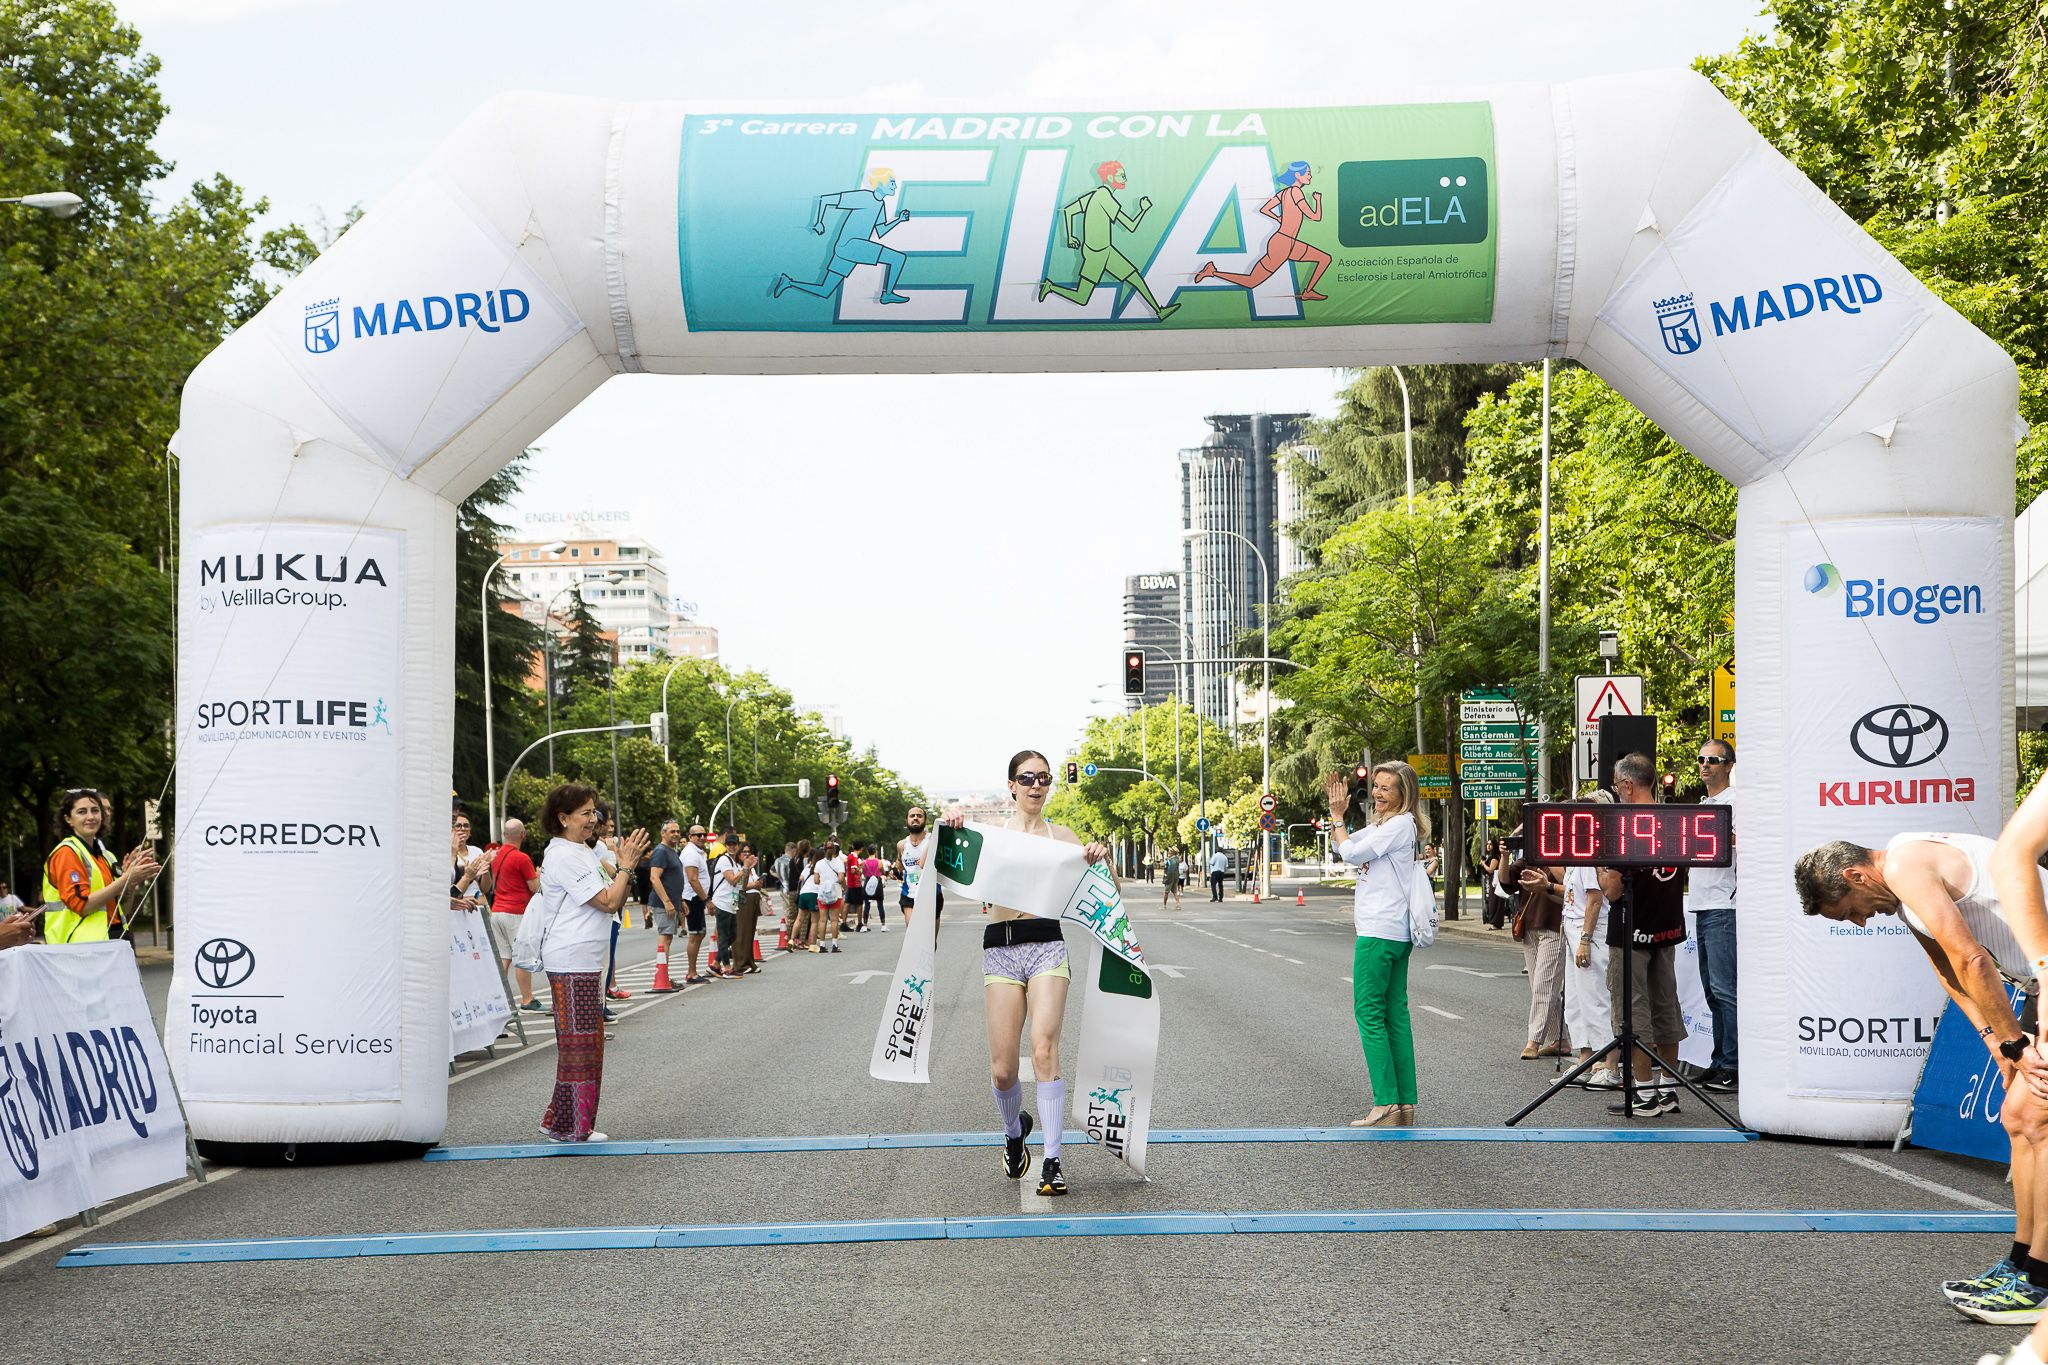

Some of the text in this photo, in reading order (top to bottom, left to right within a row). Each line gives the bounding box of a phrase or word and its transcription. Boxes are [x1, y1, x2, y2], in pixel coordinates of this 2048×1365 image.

[740, 119, 858, 135] Carrera
[871, 116, 1072, 140] MADRID
[1087, 115, 1191, 138] CON
[1205, 113, 1267, 136] LA
[1359, 195, 1468, 228] adELA
[832, 141, 1305, 325] ELA
[1338, 254, 1459, 268] Asociación Española de
[1337, 268, 1488, 283] Esclerosis Lateral Amiotrófica
[353, 288, 530, 339] MADRID
[1709, 273, 1883, 337] MADRID
[201, 553, 387, 588] MUKUA
[1140, 576, 1177, 589] BBVA
[201, 594, 217, 614] by
[314, 731, 321, 740] Y
[323, 731, 367, 742] EVENTOS
[1481, 731, 1515, 739] Germán
[1540, 813, 1717, 858] 00:19:15
[1830, 925, 1912, 936] Flexible Mobil
[191, 1003, 257, 1028] Toyota
[885, 989, 912, 1062] SPORT
[190, 1032, 393, 1054] Financial Services
[899, 1004, 924, 1059] LIFE
[1799, 1046, 1851, 1058] MOVILIDAD,
[16, 1025, 158, 1140] MADRID
[1087, 1102, 1105, 1144] ORT
